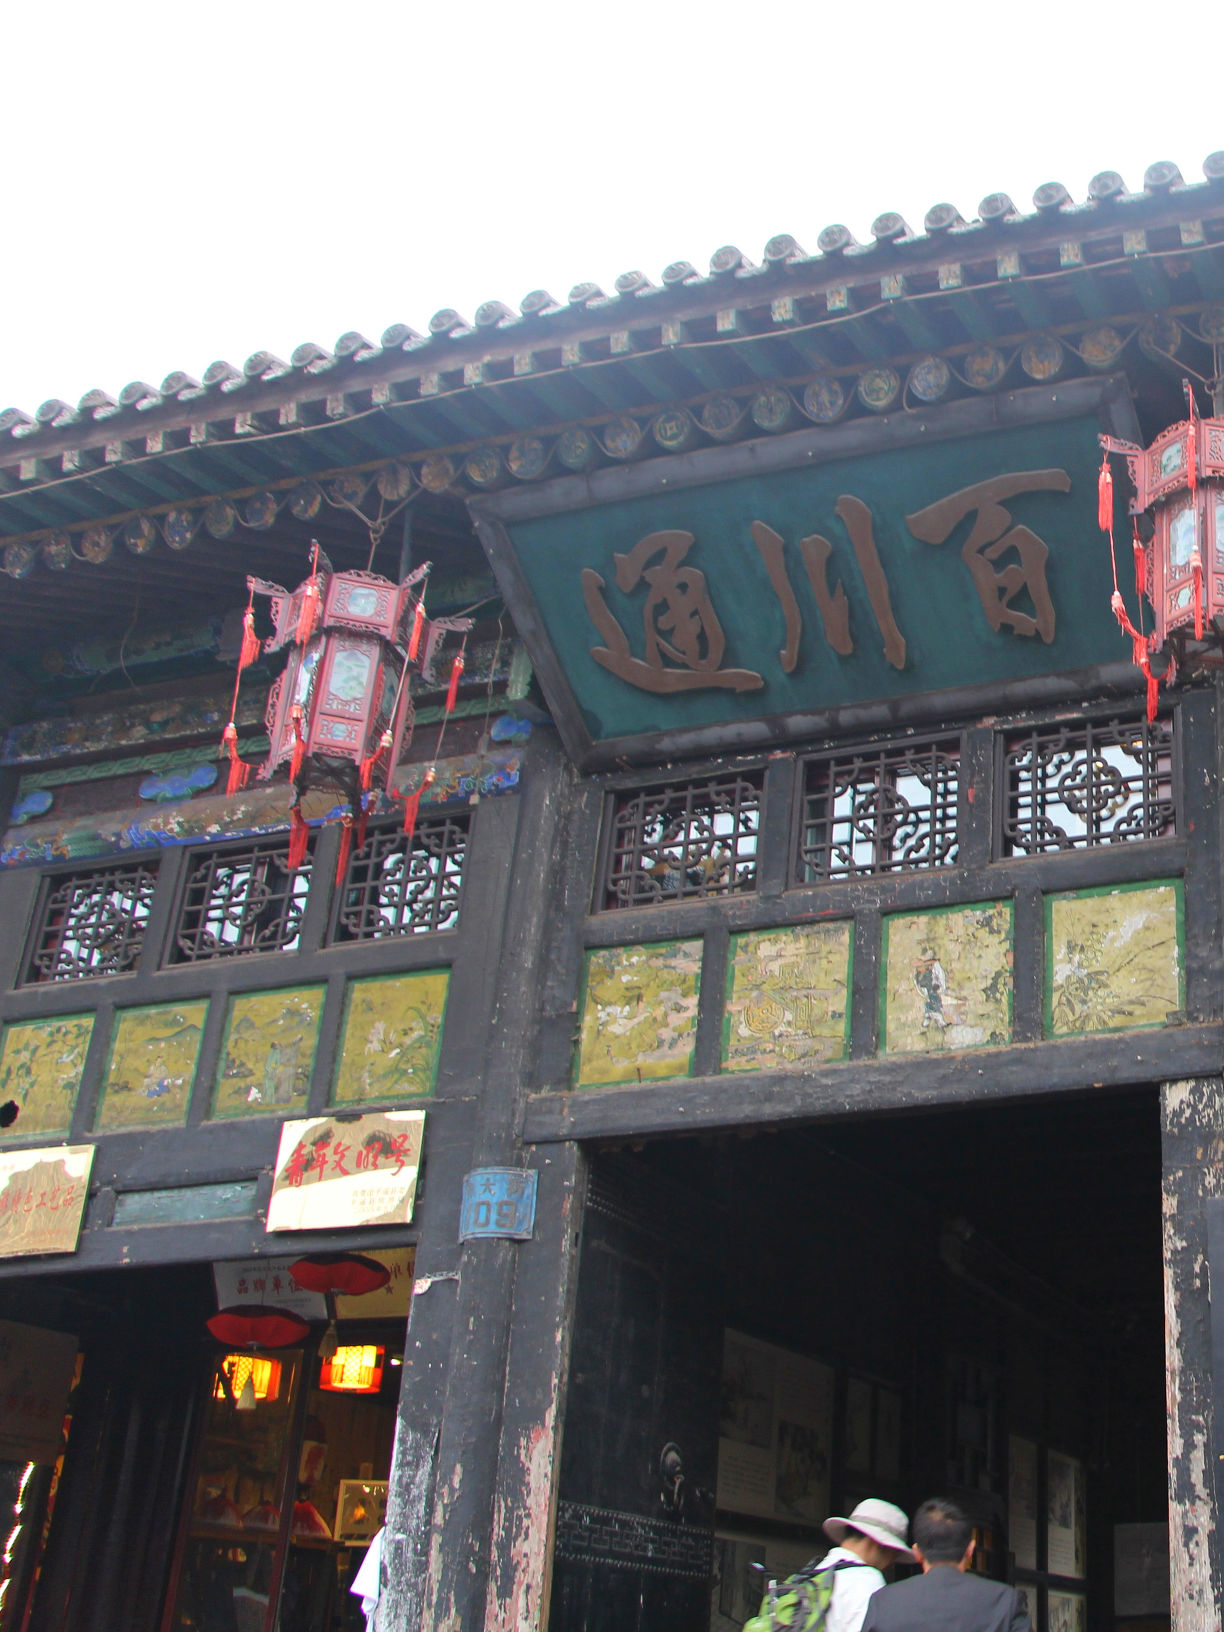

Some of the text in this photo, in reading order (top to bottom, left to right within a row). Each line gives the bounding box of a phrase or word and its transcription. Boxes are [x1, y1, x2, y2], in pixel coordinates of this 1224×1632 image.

[581, 468, 1071, 694] 百川通
[285, 1133, 411, 1187] 青年文明号
